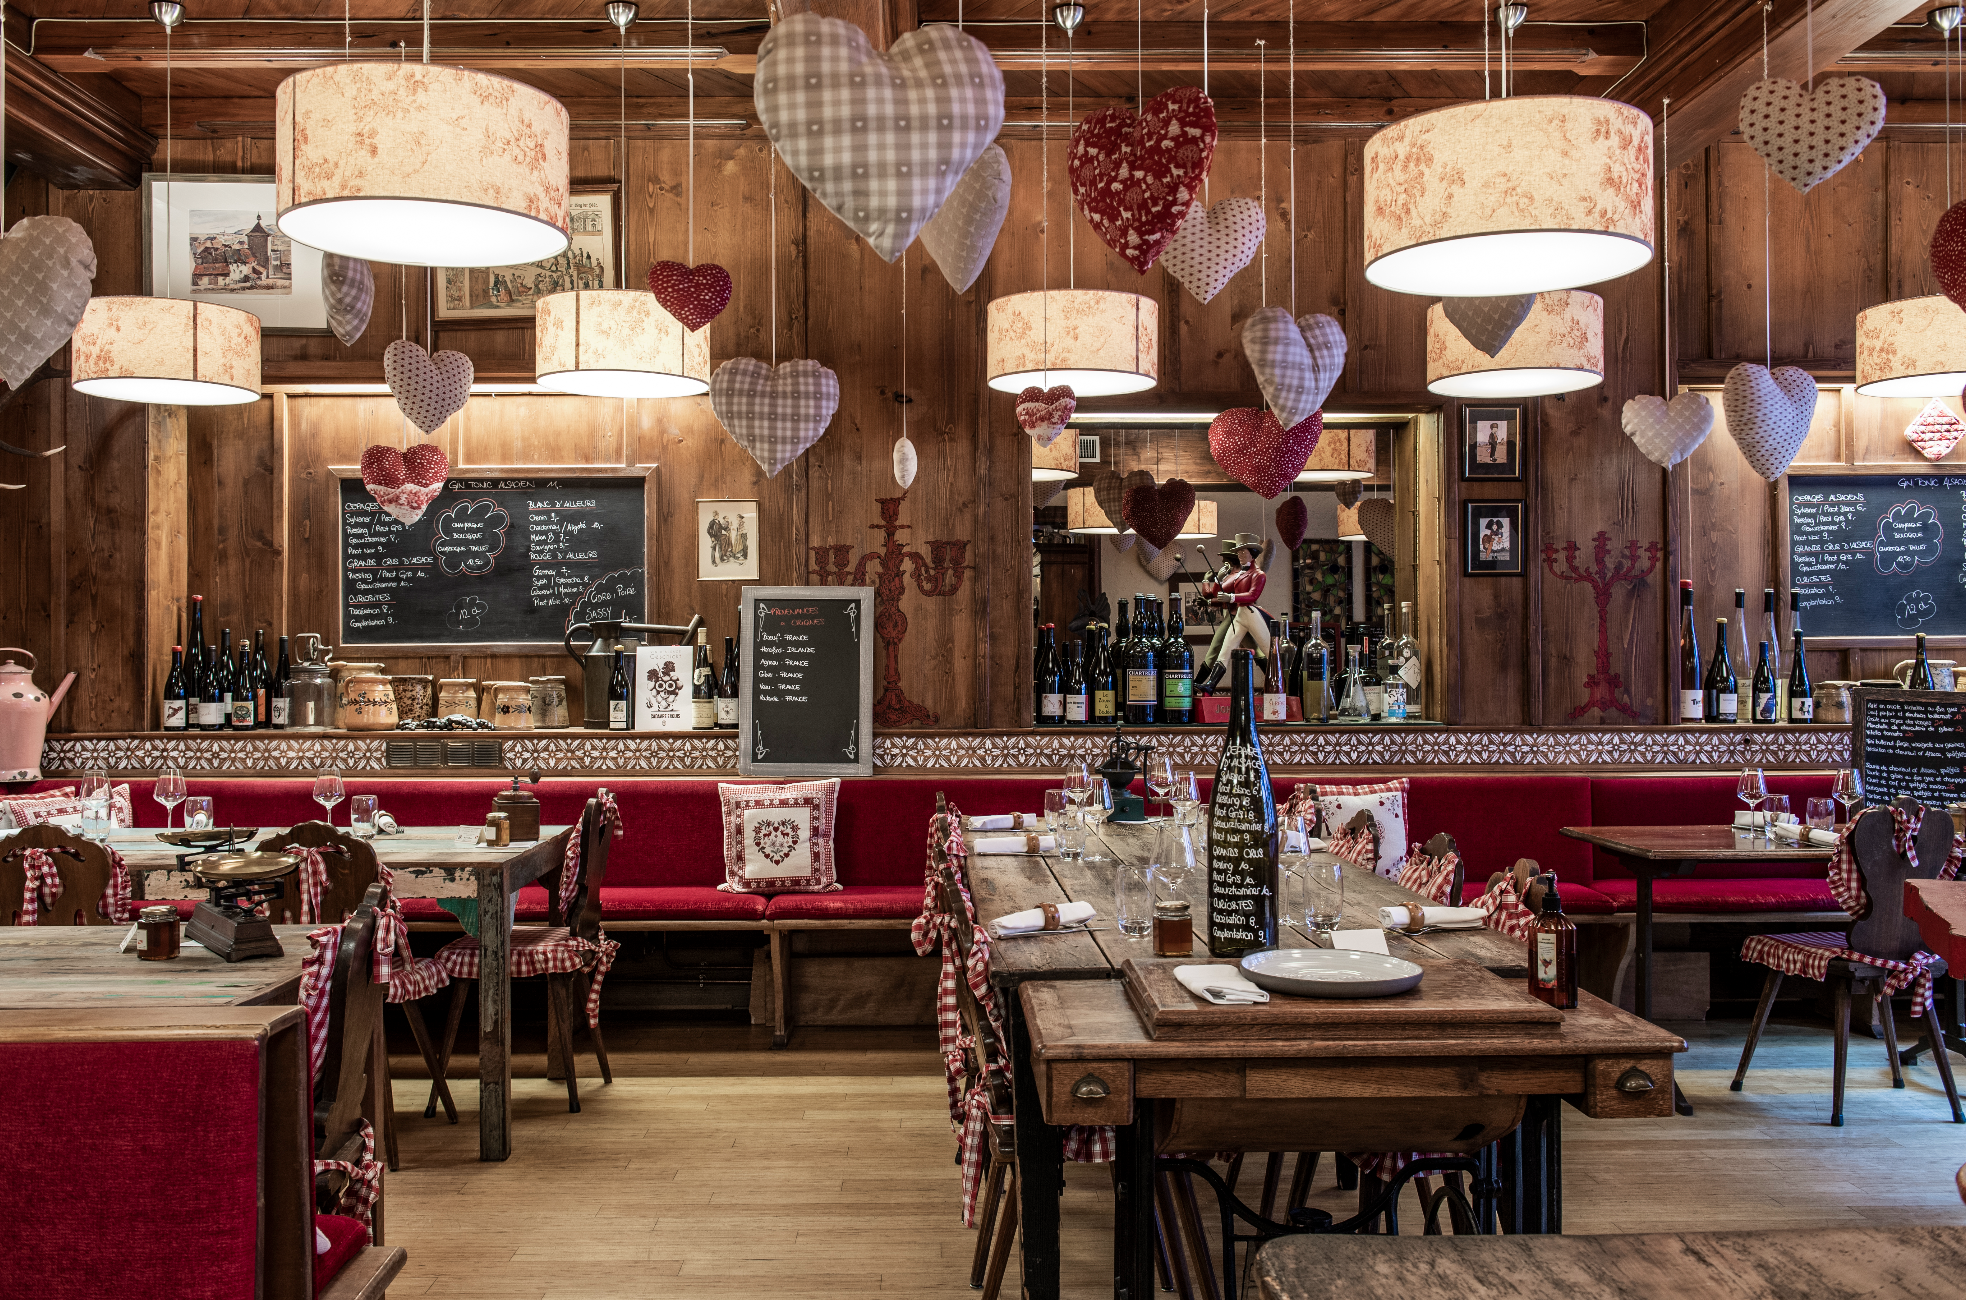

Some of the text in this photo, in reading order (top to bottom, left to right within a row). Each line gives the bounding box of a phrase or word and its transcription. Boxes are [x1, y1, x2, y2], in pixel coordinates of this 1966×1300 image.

[448, 481, 465, 490] GIN
[468, 481, 493, 489] TONIC
[498, 480, 535, 489] ALSACIEN
[1898, 478, 1939, 489] GIN TONIC
[1829, 493, 1865, 502] ALSACIENS
[527, 501, 551, 509] BLANC
[1793, 505, 1817, 515] Sylvaner
[345, 514, 371, 524] Sylvaner
[1793, 516, 1815, 526] Riesling
[345, 526, 369, 536] Riesling
[451, 522, 484, 530] CHAMPAGNE
[348, 546, 362, 555] Pinot
[530, 543, 557, 552] Sauvignon
[1795, 540, 1874, 553] GRANDS CRUS D'ALSACE
[529, 552, 552, 560] ROUGE
[1793, 555, 1816, 565] Riesling
[346, 556, 434, 569] GRANDS CRUS D'ALSACE
[347, 571, 373, 581] Riesling
[382, 570, 397, 578] Pinot
[533, 597, 547, 606] Pinot
[1799, 599, 1835, 610] omplantation
[585, 606, 612, 620] SASSY
[771, 607, 819, 616] PROVENANCES
[785, 659, 809, 667] FRANCE
[780, 671, 803, 679] FRANCE
[1224, 758, 1262, 769] D'ALSACE
[1218, 782, 1231, 793] Pinot
[1216, 793, 1240, 809] Riesling
[1214, 804, 1226, 817] Pinot
[1228, 808, 1243, 819] Gris
[1212, 829, 1225, 840] Pinot
[1227, 833, 1240, 841] Noir
[1213, 845, 1264, 858] GRANDS CRUS
[1213, 859, 1234, 873] Riesling
[1213, 870, 1225, 882] Pinot
[1226, 873, 1241, 884] Gris
